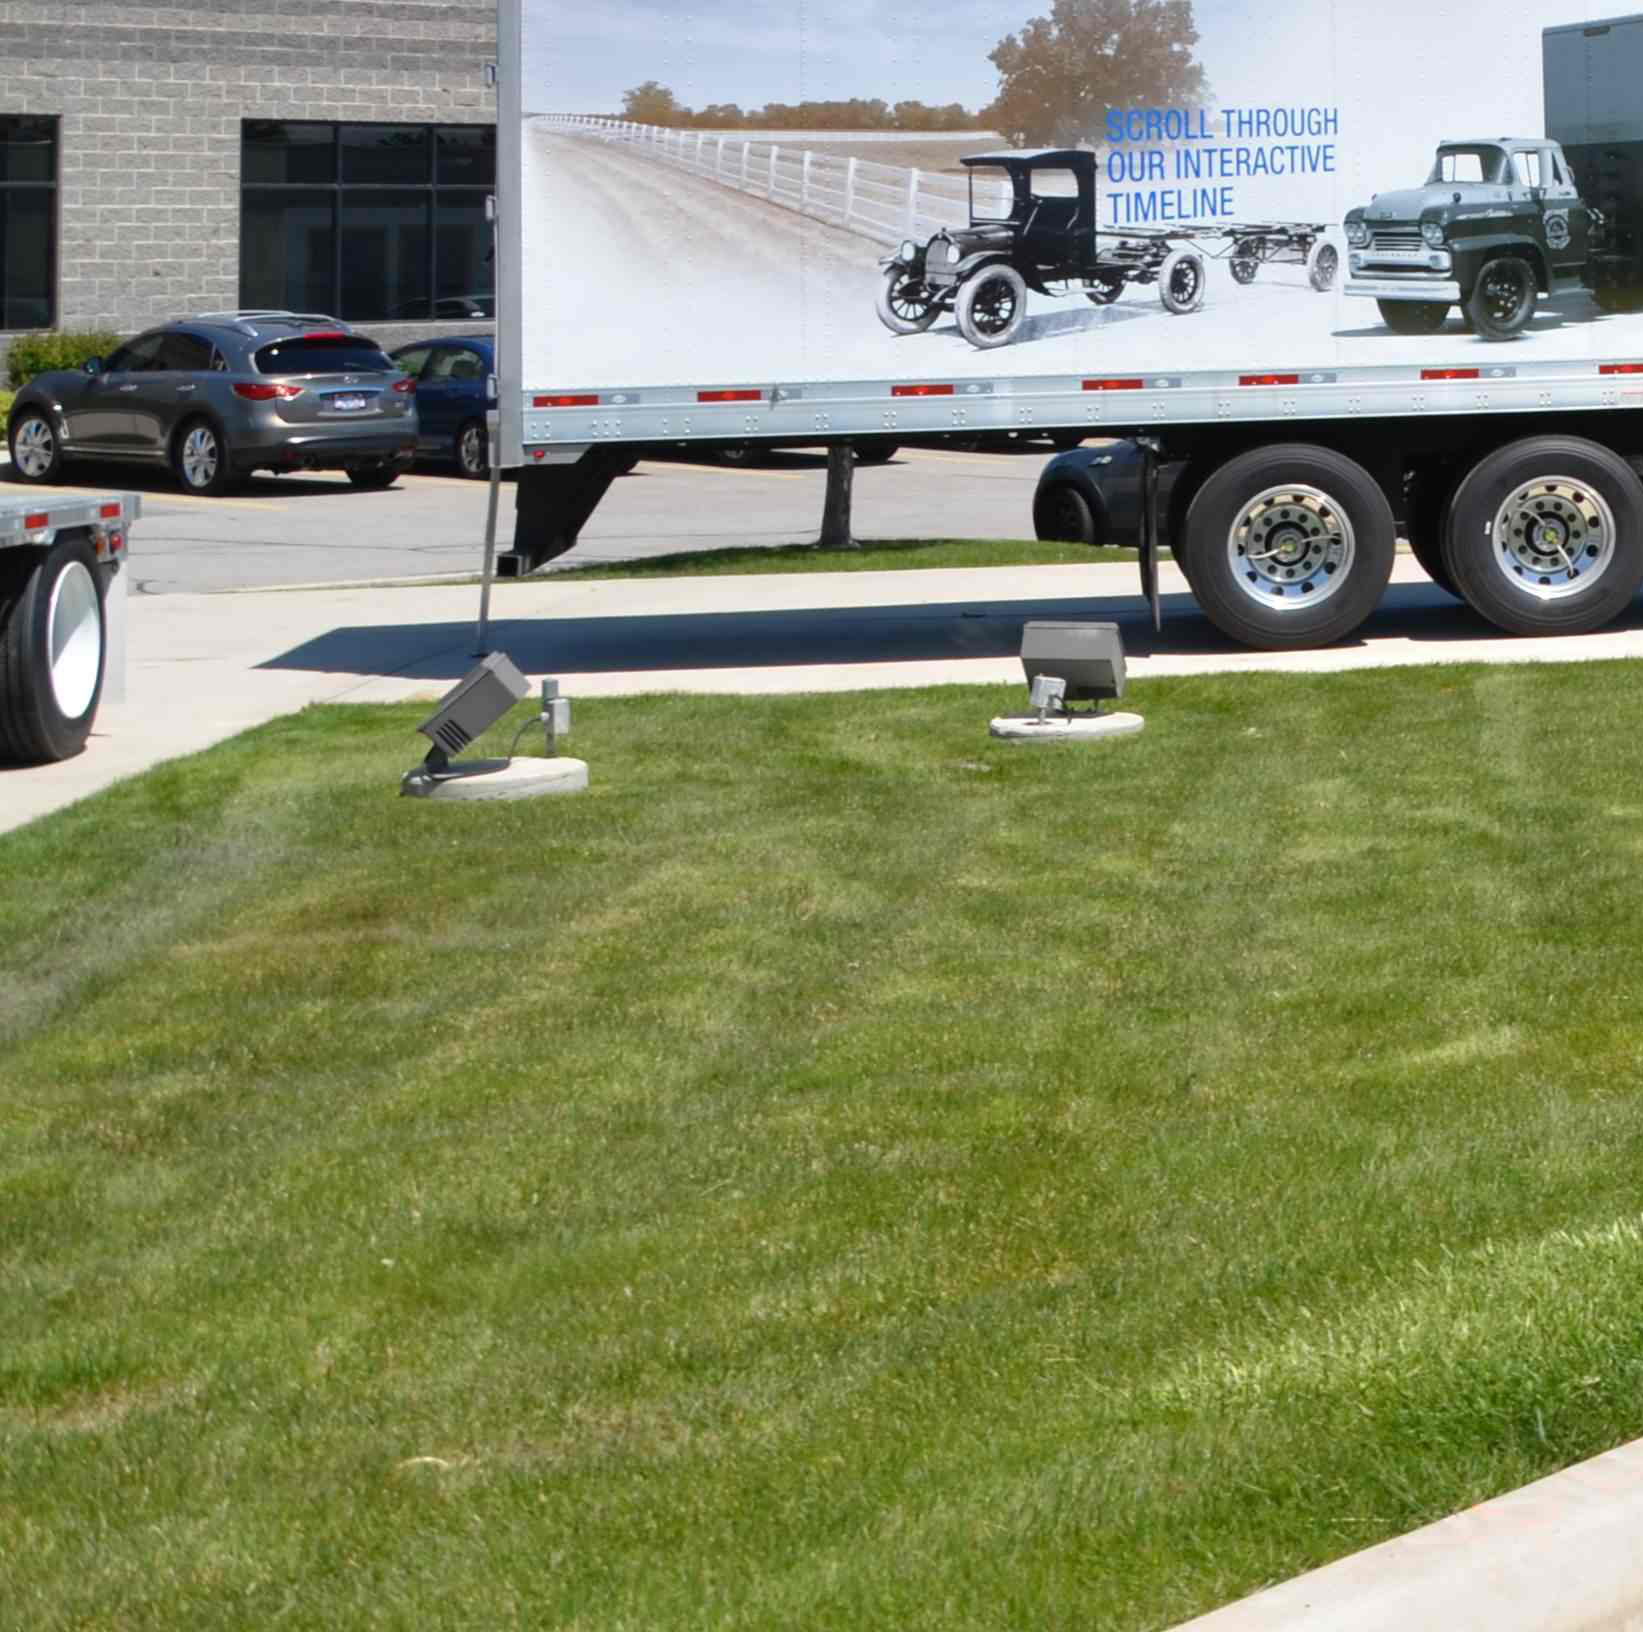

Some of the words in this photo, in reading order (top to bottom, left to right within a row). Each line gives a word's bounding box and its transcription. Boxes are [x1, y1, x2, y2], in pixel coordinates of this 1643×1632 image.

[1105, 108, 1214, 143] SCROLL
[1220, 107, 1338, 138] THROUGH
[1106, 150, 1165, 183] OUR
[1176, 144, 1336, 179] INTERACTIVE
[1106, 186, 1235, 225] TIMELINE
